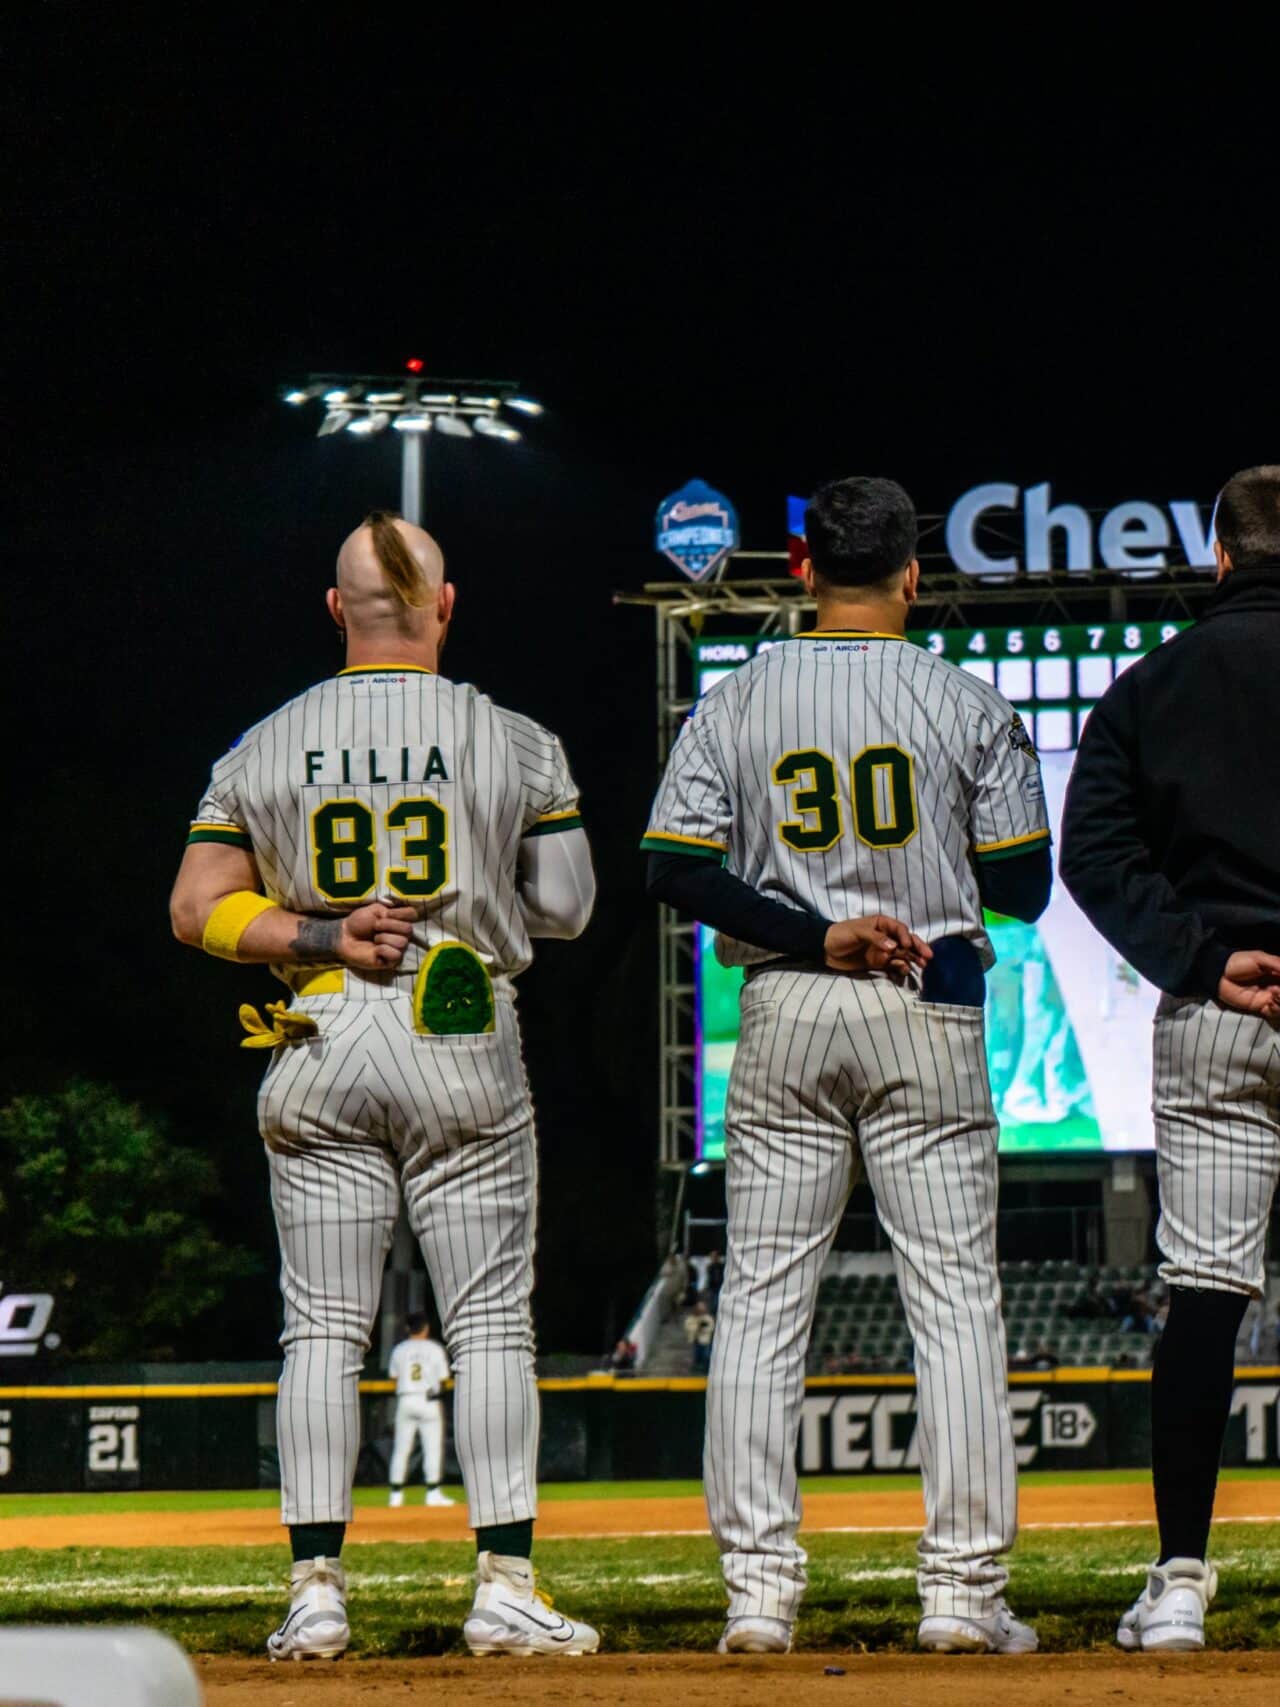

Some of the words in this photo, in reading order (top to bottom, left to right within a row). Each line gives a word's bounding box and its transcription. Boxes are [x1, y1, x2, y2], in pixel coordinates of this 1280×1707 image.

[699, 643, 748, 662] HORA
[927, 632, 945, 655] 3
[968, 631, 986, 653] 4
[1006, 630, 1024, 653] 5
[1044, 628, 1061, 651] 6
[1087, 627, 1105, 649] 7
[1123, 625, 1141, 649] 8
[305, 746, 449, 784] FILIA
[771, 743, 918, 852] 30
[311, 797, 450, 901] 83
[410, 1363, 422, 1381] 2
[88, 1424, 140, 1472] 21
[800, 1390, 1043, 1472] TECE
[1046, 1408, 1092, 1442] 18+
